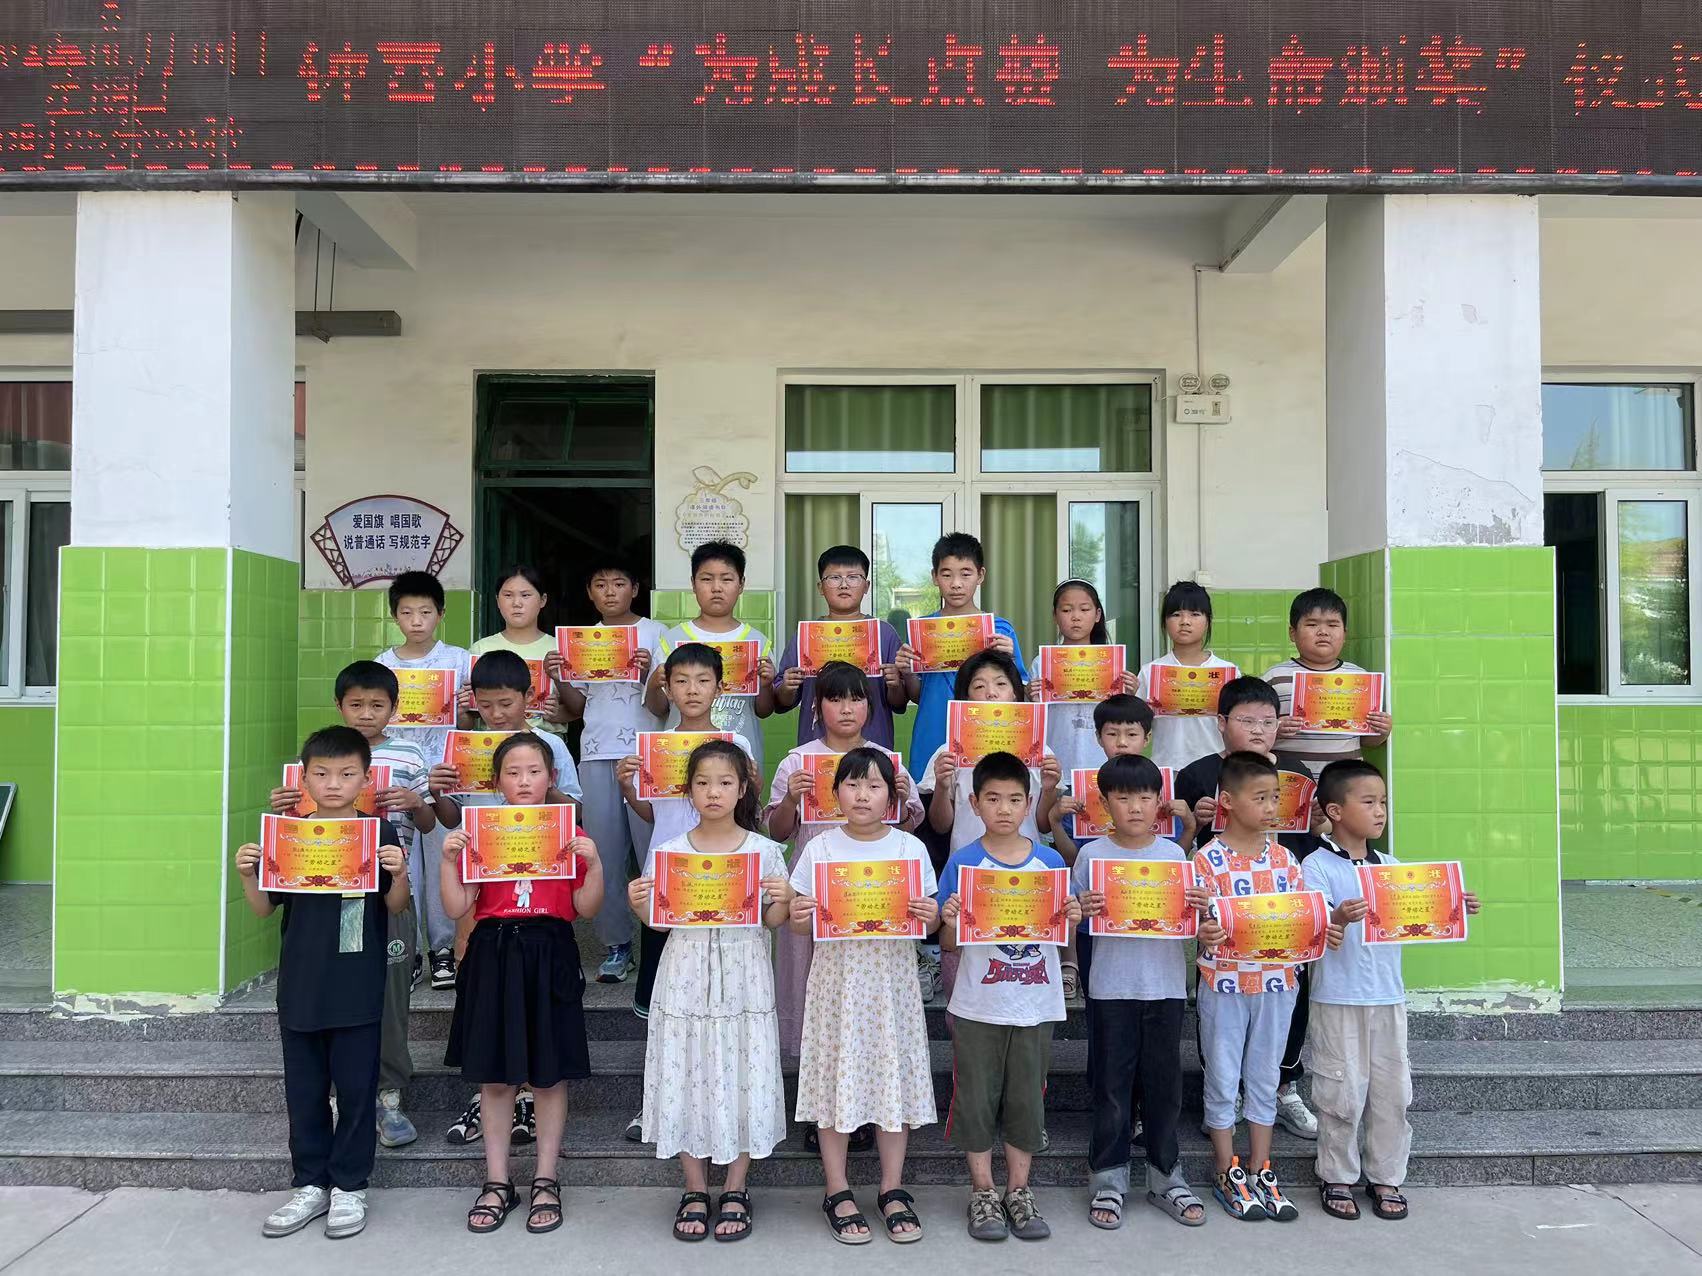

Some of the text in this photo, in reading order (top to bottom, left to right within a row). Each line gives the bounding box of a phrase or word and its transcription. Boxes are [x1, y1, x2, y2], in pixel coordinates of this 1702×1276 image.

[353, 514, 422, 528] 爱国旗 唱国歌
[344, 535, 431, 550] 说普通话 写规范字
[1208, 850, 1223, 867] G
[1234, 879, 1251, 896] G
[1217, 978, 1284, 993] G G
